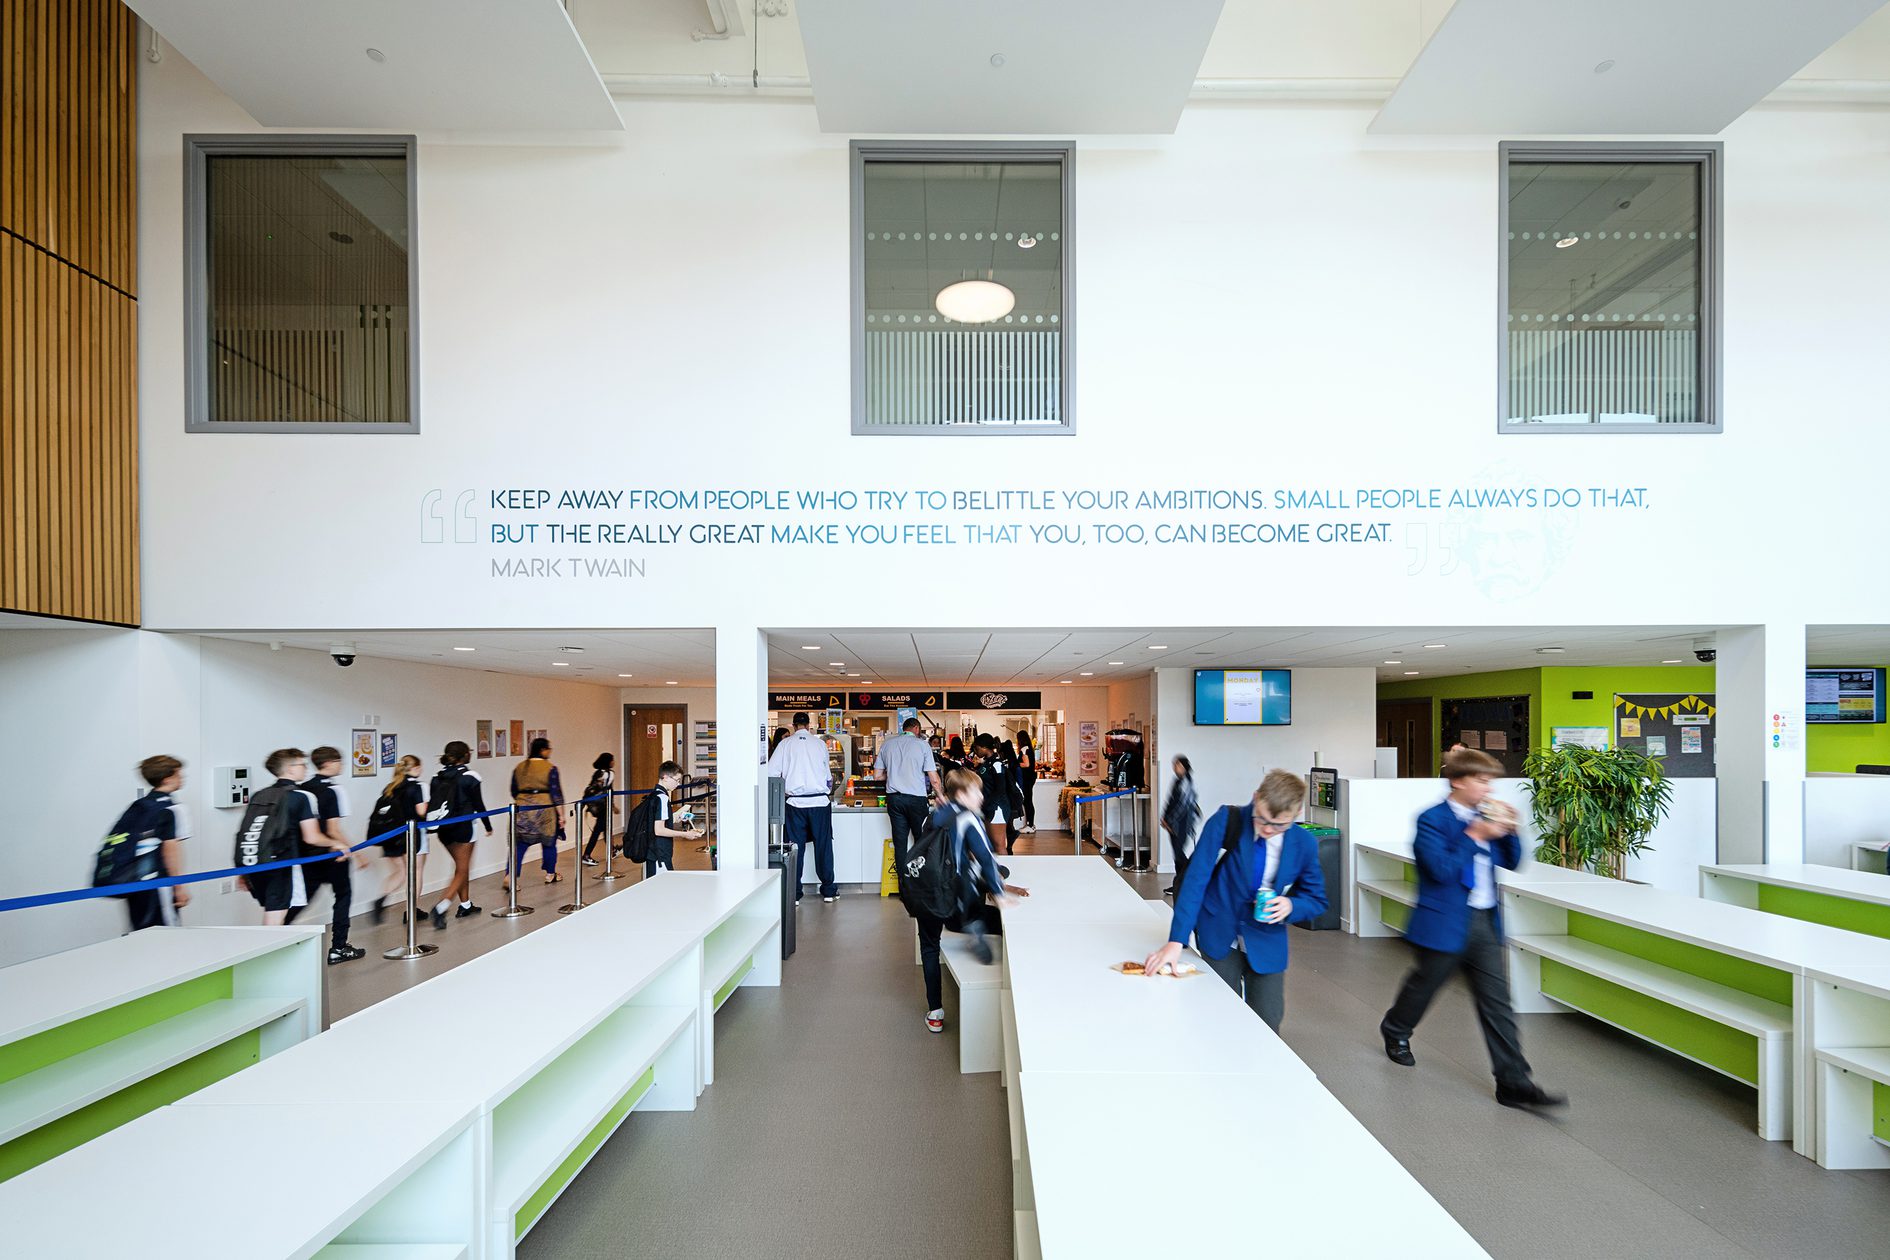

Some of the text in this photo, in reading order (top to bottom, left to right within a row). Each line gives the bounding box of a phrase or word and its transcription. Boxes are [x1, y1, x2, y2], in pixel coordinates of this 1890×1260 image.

[491, 488, 1649, 510] KEEP AWAY FROM PEOPLE WHO TRY TO BELITTLE YOUR AMBITIONS. SMALL PEOPLE ALWAYS DO THAT,
[491, 523, 1393, 546] BUT THE REALLY GREAT MAKE YOU FEEL THAT YOU, TOO, CAN BECOME GREAT.
[491, 558, 646, 578] MARK TWAIN
[240, 815, 269, 866] adidas
